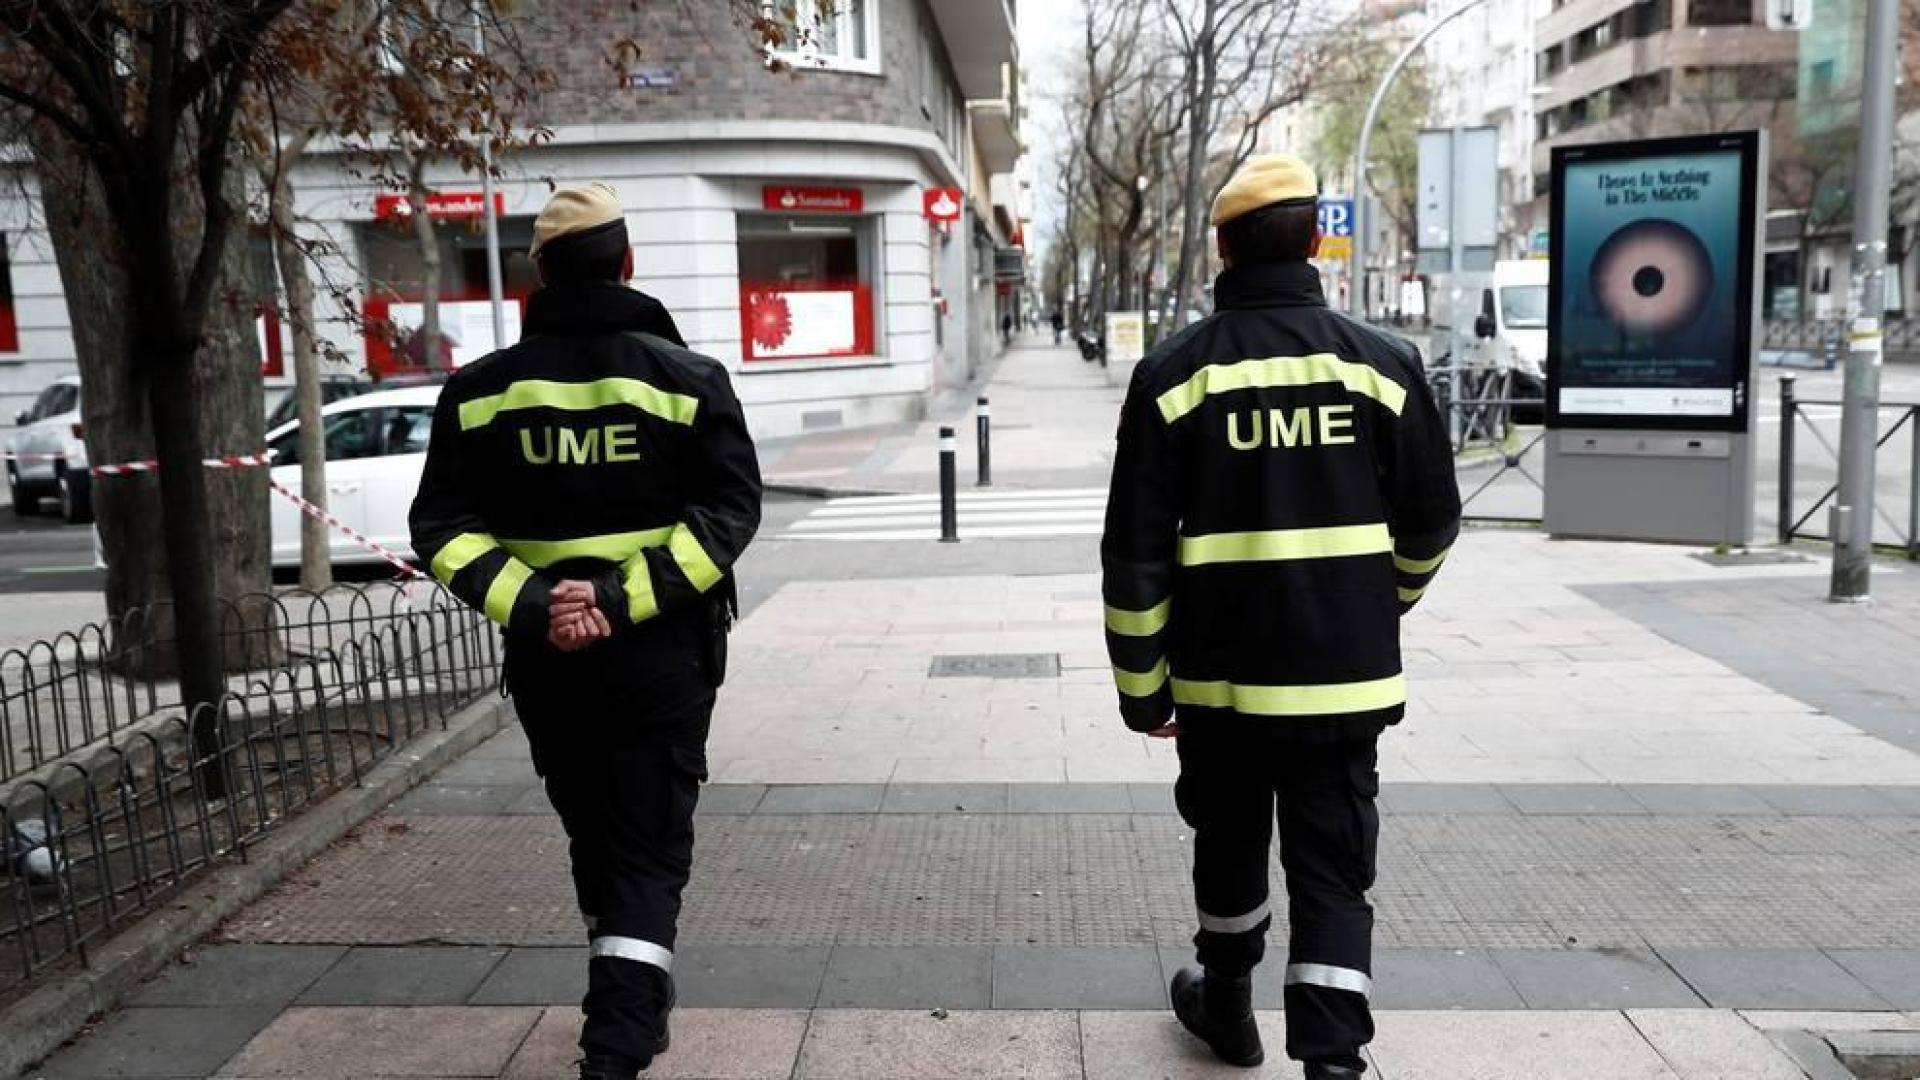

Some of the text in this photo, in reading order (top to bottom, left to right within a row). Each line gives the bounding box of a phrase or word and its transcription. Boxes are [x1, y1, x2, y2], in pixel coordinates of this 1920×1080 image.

[1659, 169, 1711, 187] Nothing
[797, 191, 850, 207] Santander
[1651, 186, 1699, 202] Middle
[1227, 404, 1356, 450] UME
[520, 424, 641, 464] UME
